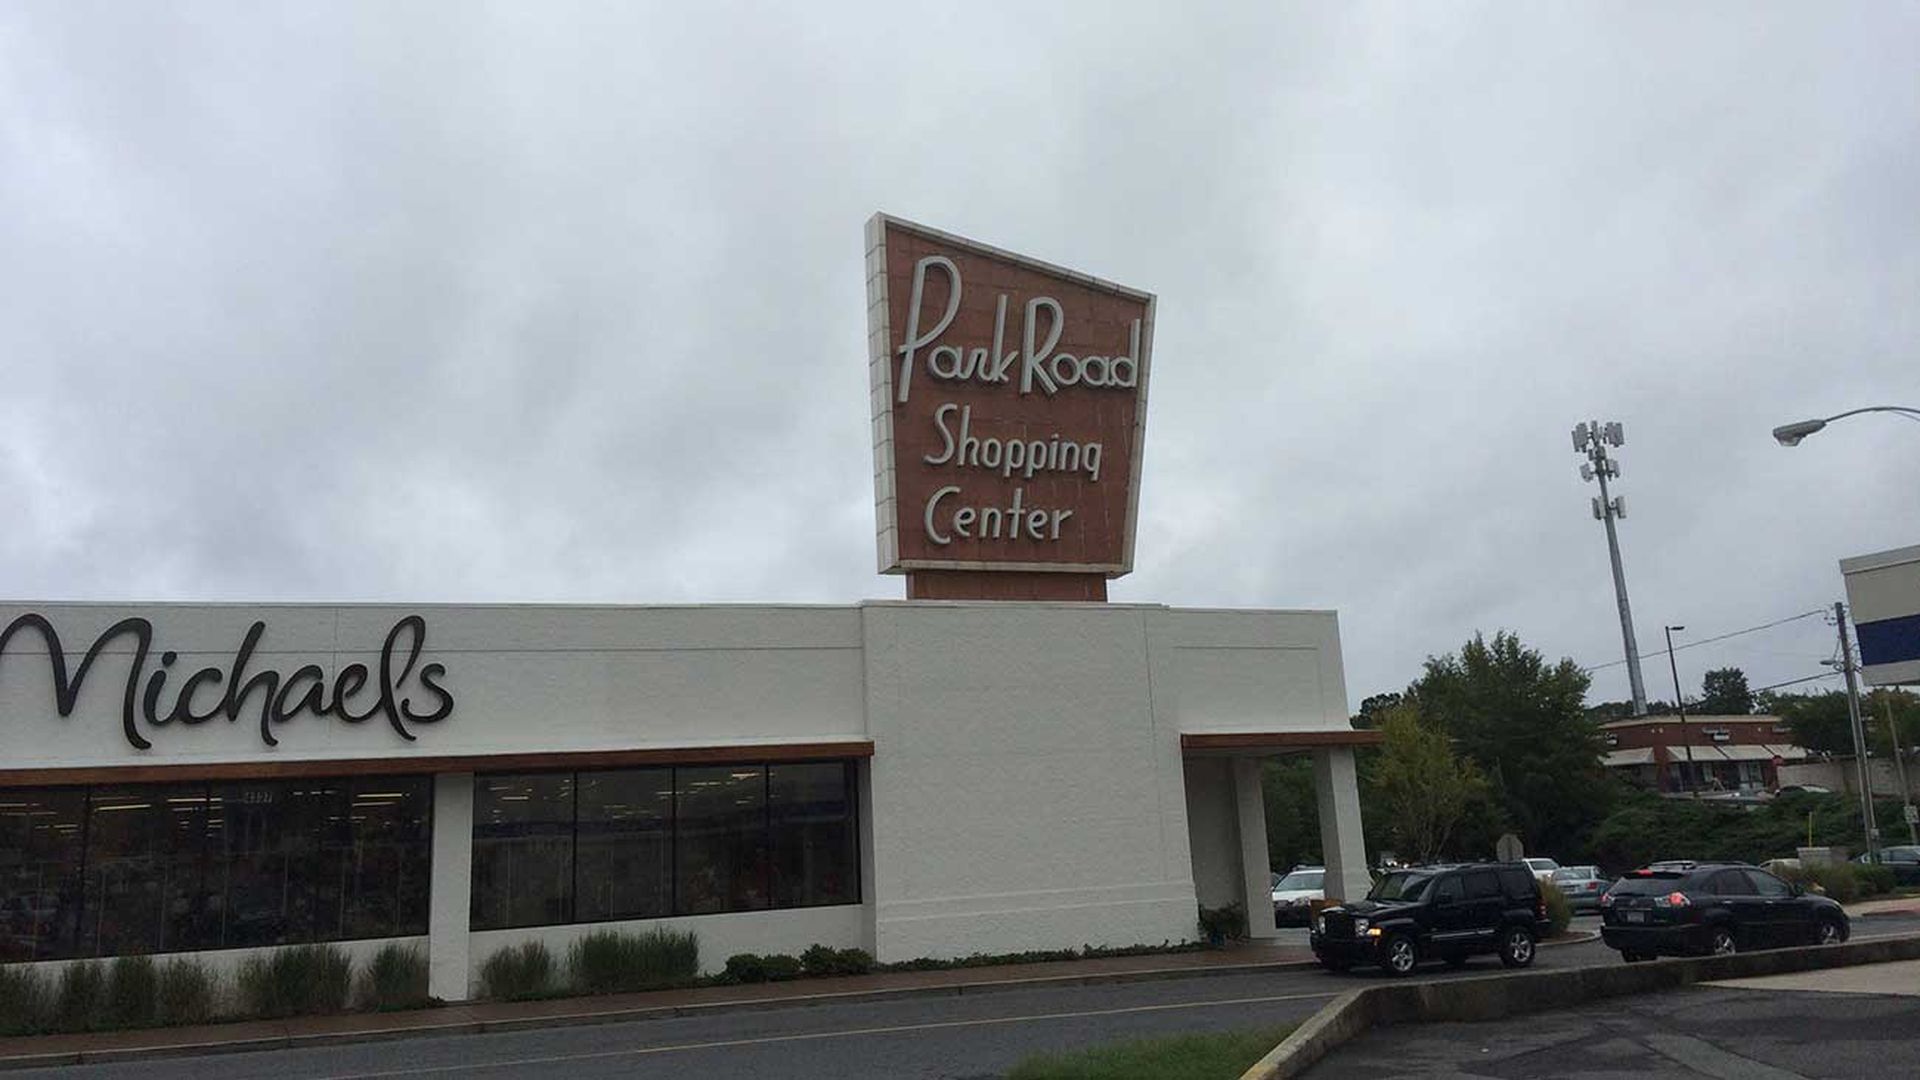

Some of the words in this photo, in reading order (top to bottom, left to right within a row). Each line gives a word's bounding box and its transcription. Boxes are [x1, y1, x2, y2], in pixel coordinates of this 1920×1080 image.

[898, 255, 1018, 403] Park
[1018, 295, 1141, 395] Road
[923, 402, 1103, 482] Shopping
[924, 485, 1074, 545] Center
[0, 613, 455, 750] Michaels
